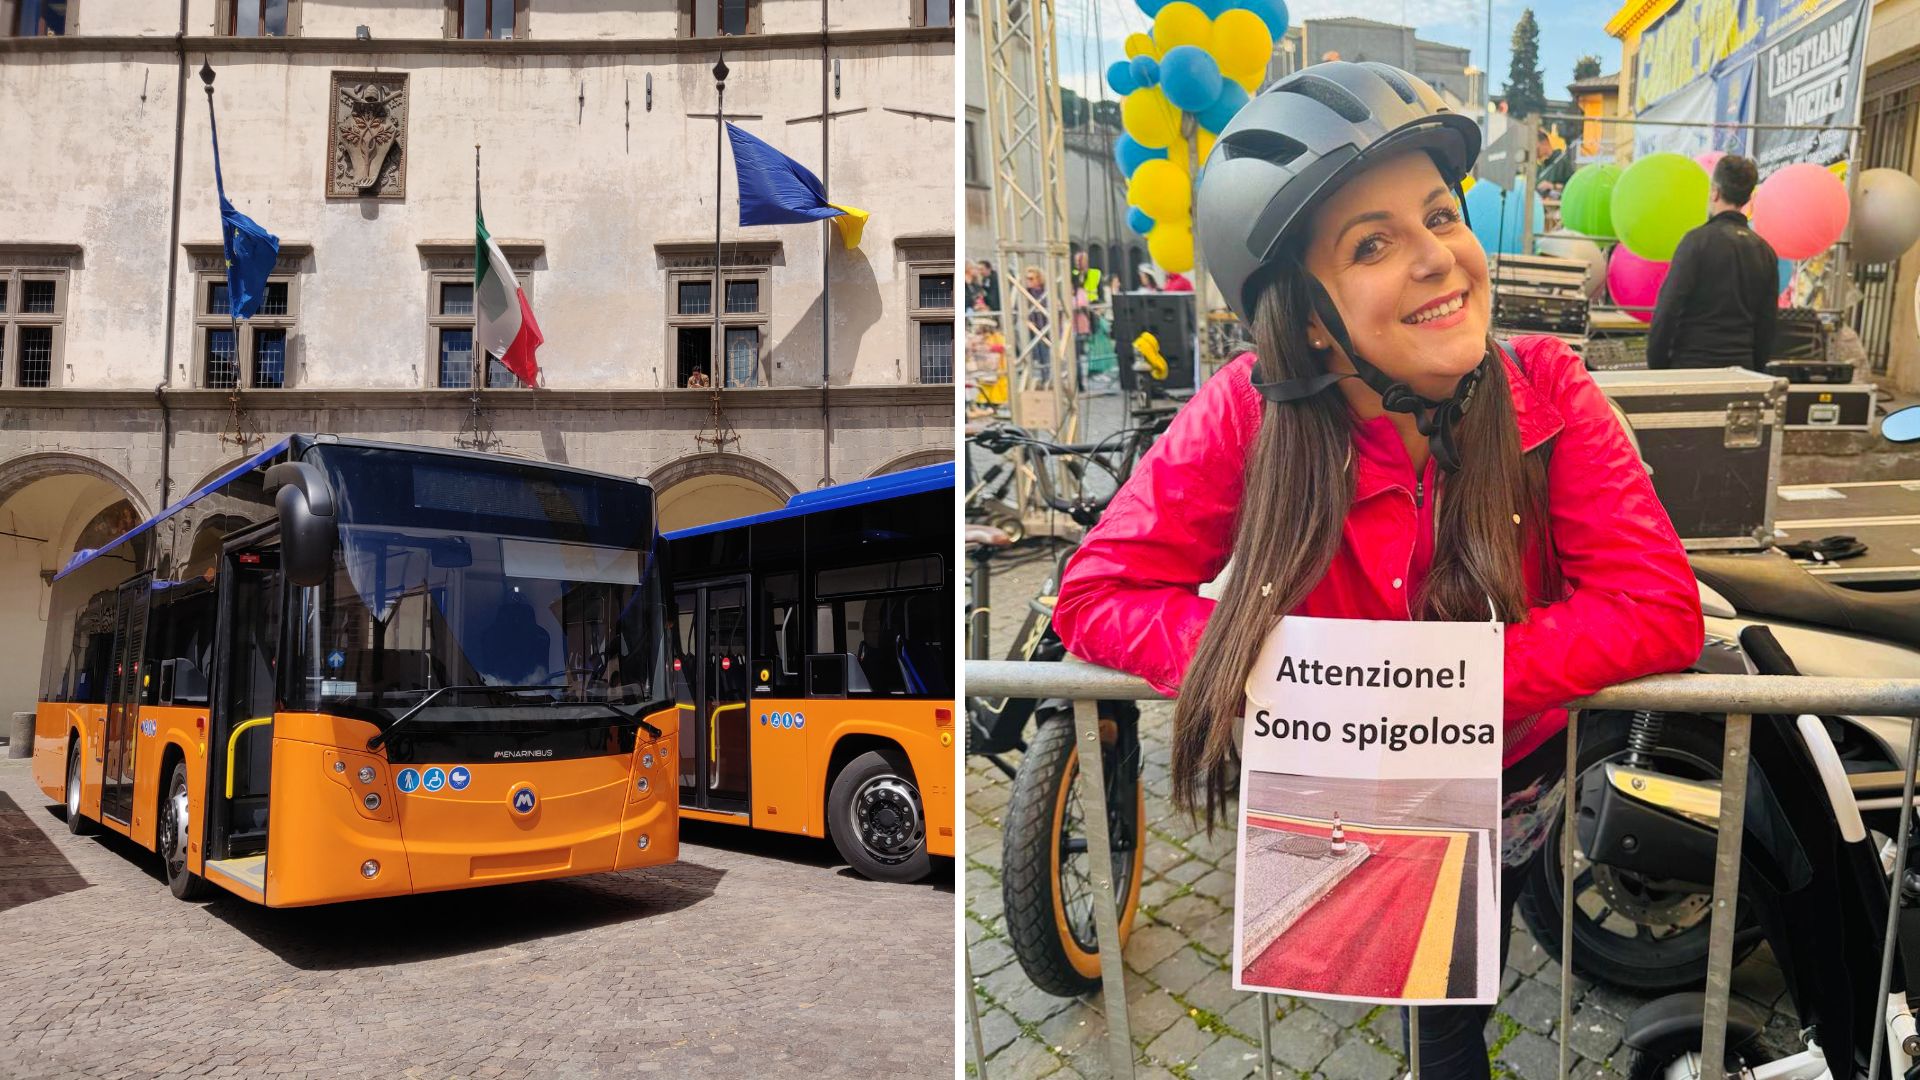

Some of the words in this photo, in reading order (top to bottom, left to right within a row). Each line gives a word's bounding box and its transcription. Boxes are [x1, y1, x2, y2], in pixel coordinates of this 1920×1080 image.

[1768, 14, 1853, 98] CRISTIANO
[1276, 655, 1466, 689] Attenzione!
[1254, 710, 1331, 742] Sono
[1342, 716, 1495, 751] spigolosa
